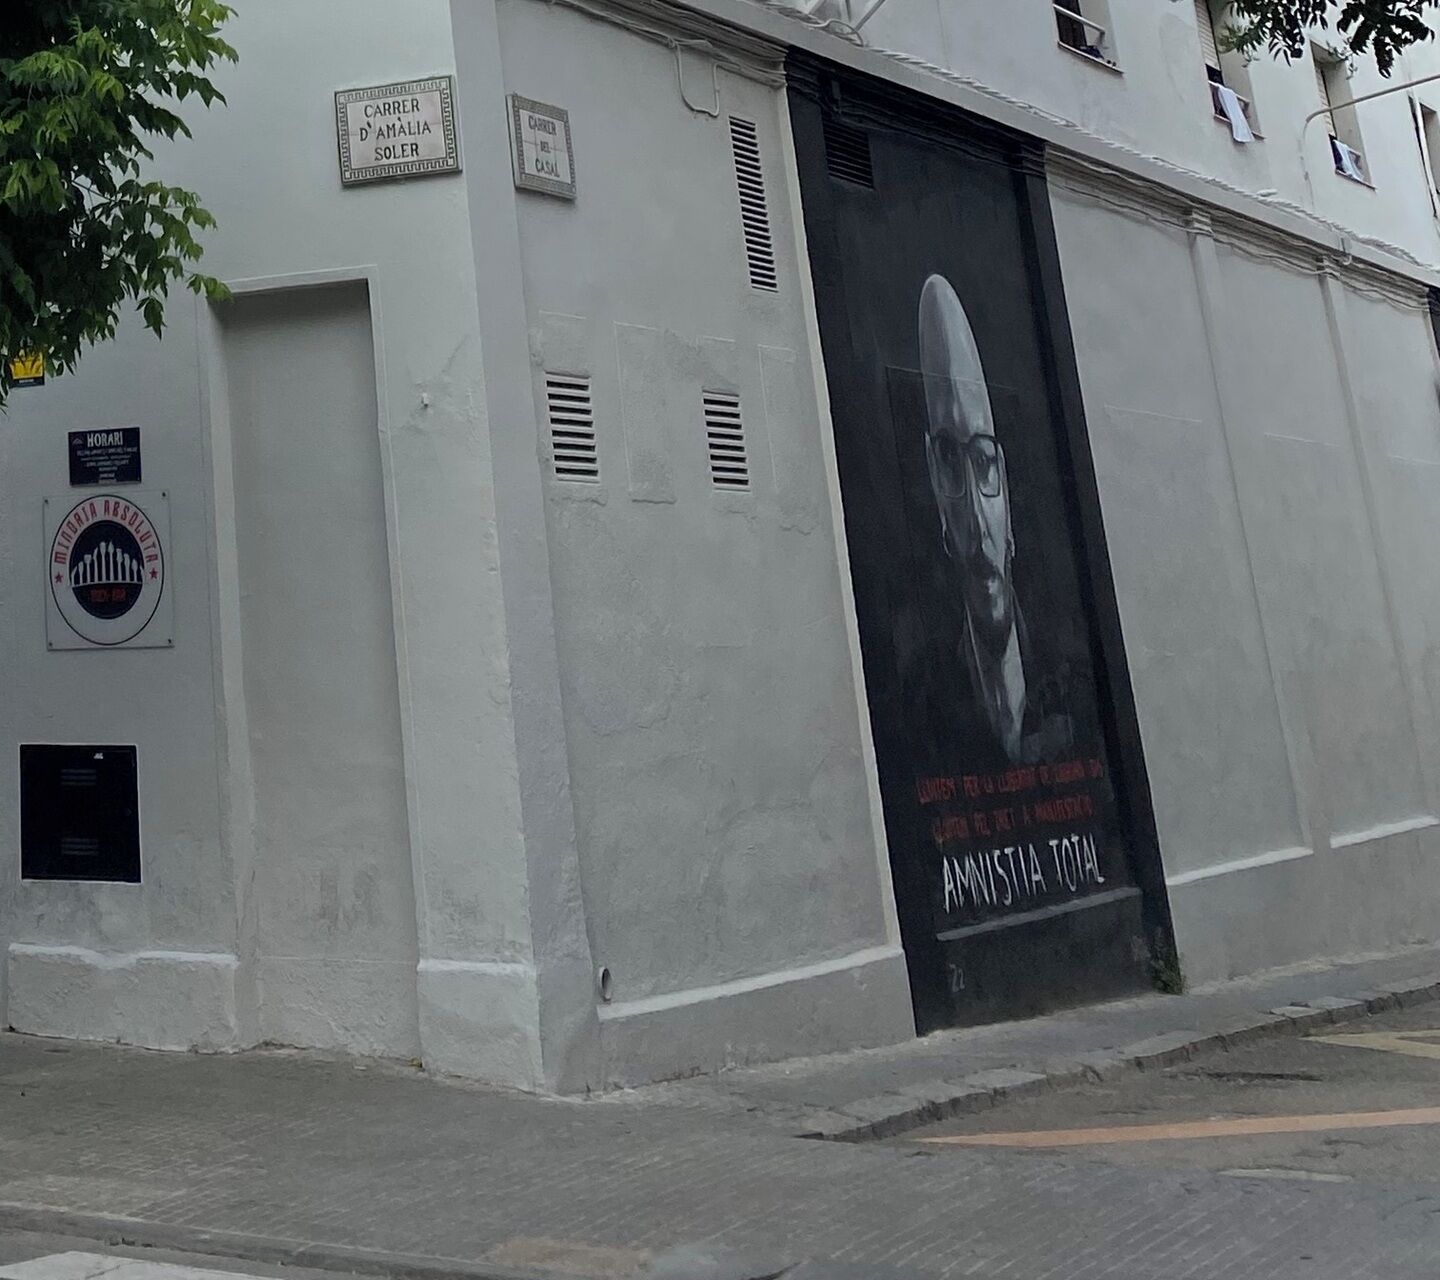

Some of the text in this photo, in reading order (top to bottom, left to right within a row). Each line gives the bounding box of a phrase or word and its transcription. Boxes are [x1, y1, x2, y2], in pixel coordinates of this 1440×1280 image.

[364, 98, 420, 119] CARRER
[528, 114, 557, 136] CARRER
[374, 142, 419, 162] SOLER
[535, 157, 560, 178] CASAL
[86, 430, 124, 448] HORARI
[54, 499, 158, 565] MINORIA ABSOLUTA
[942, 832, 1106, 914] AMNISTIA TOTAL
